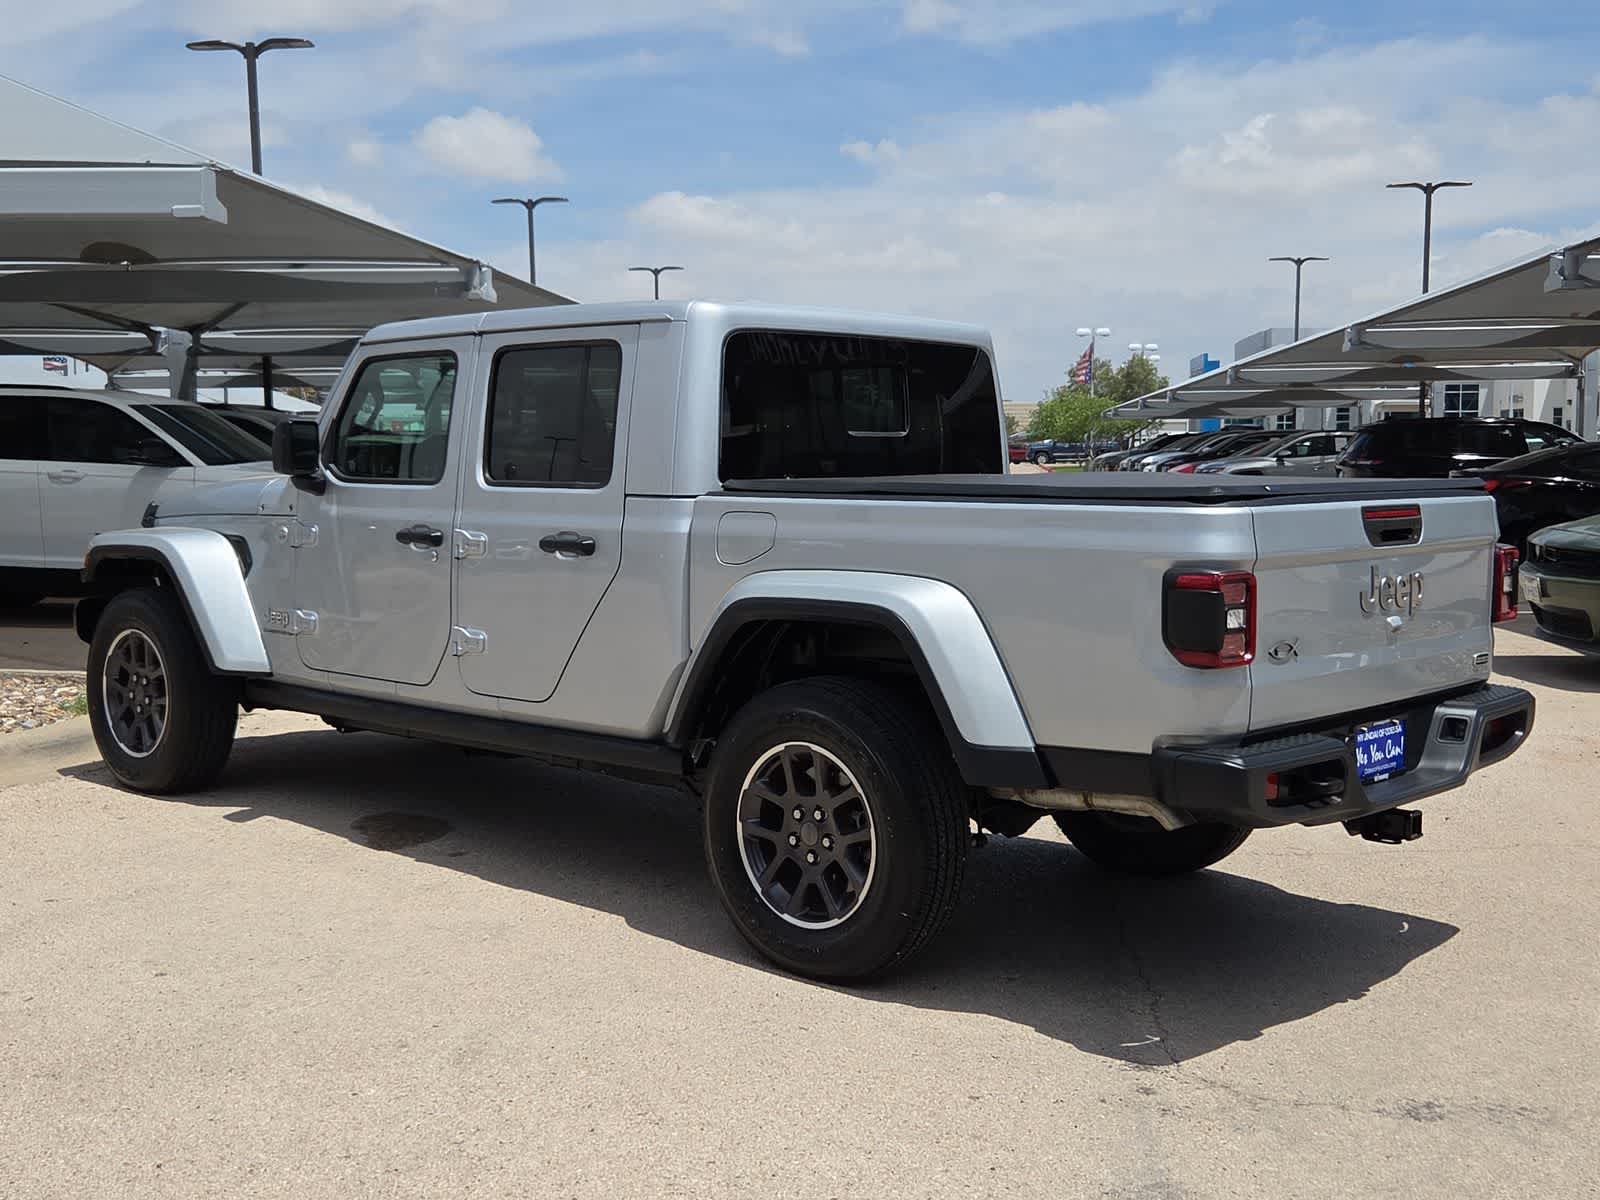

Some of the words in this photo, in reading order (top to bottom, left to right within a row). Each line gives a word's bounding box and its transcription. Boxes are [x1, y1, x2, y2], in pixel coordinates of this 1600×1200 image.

[1359, 564, 1425, 618] Jeep
[1356, 747, 1367, 767] Yes
[1370, 743, 1384, 762] You
[1386, 735, 1403, 758] Can!
